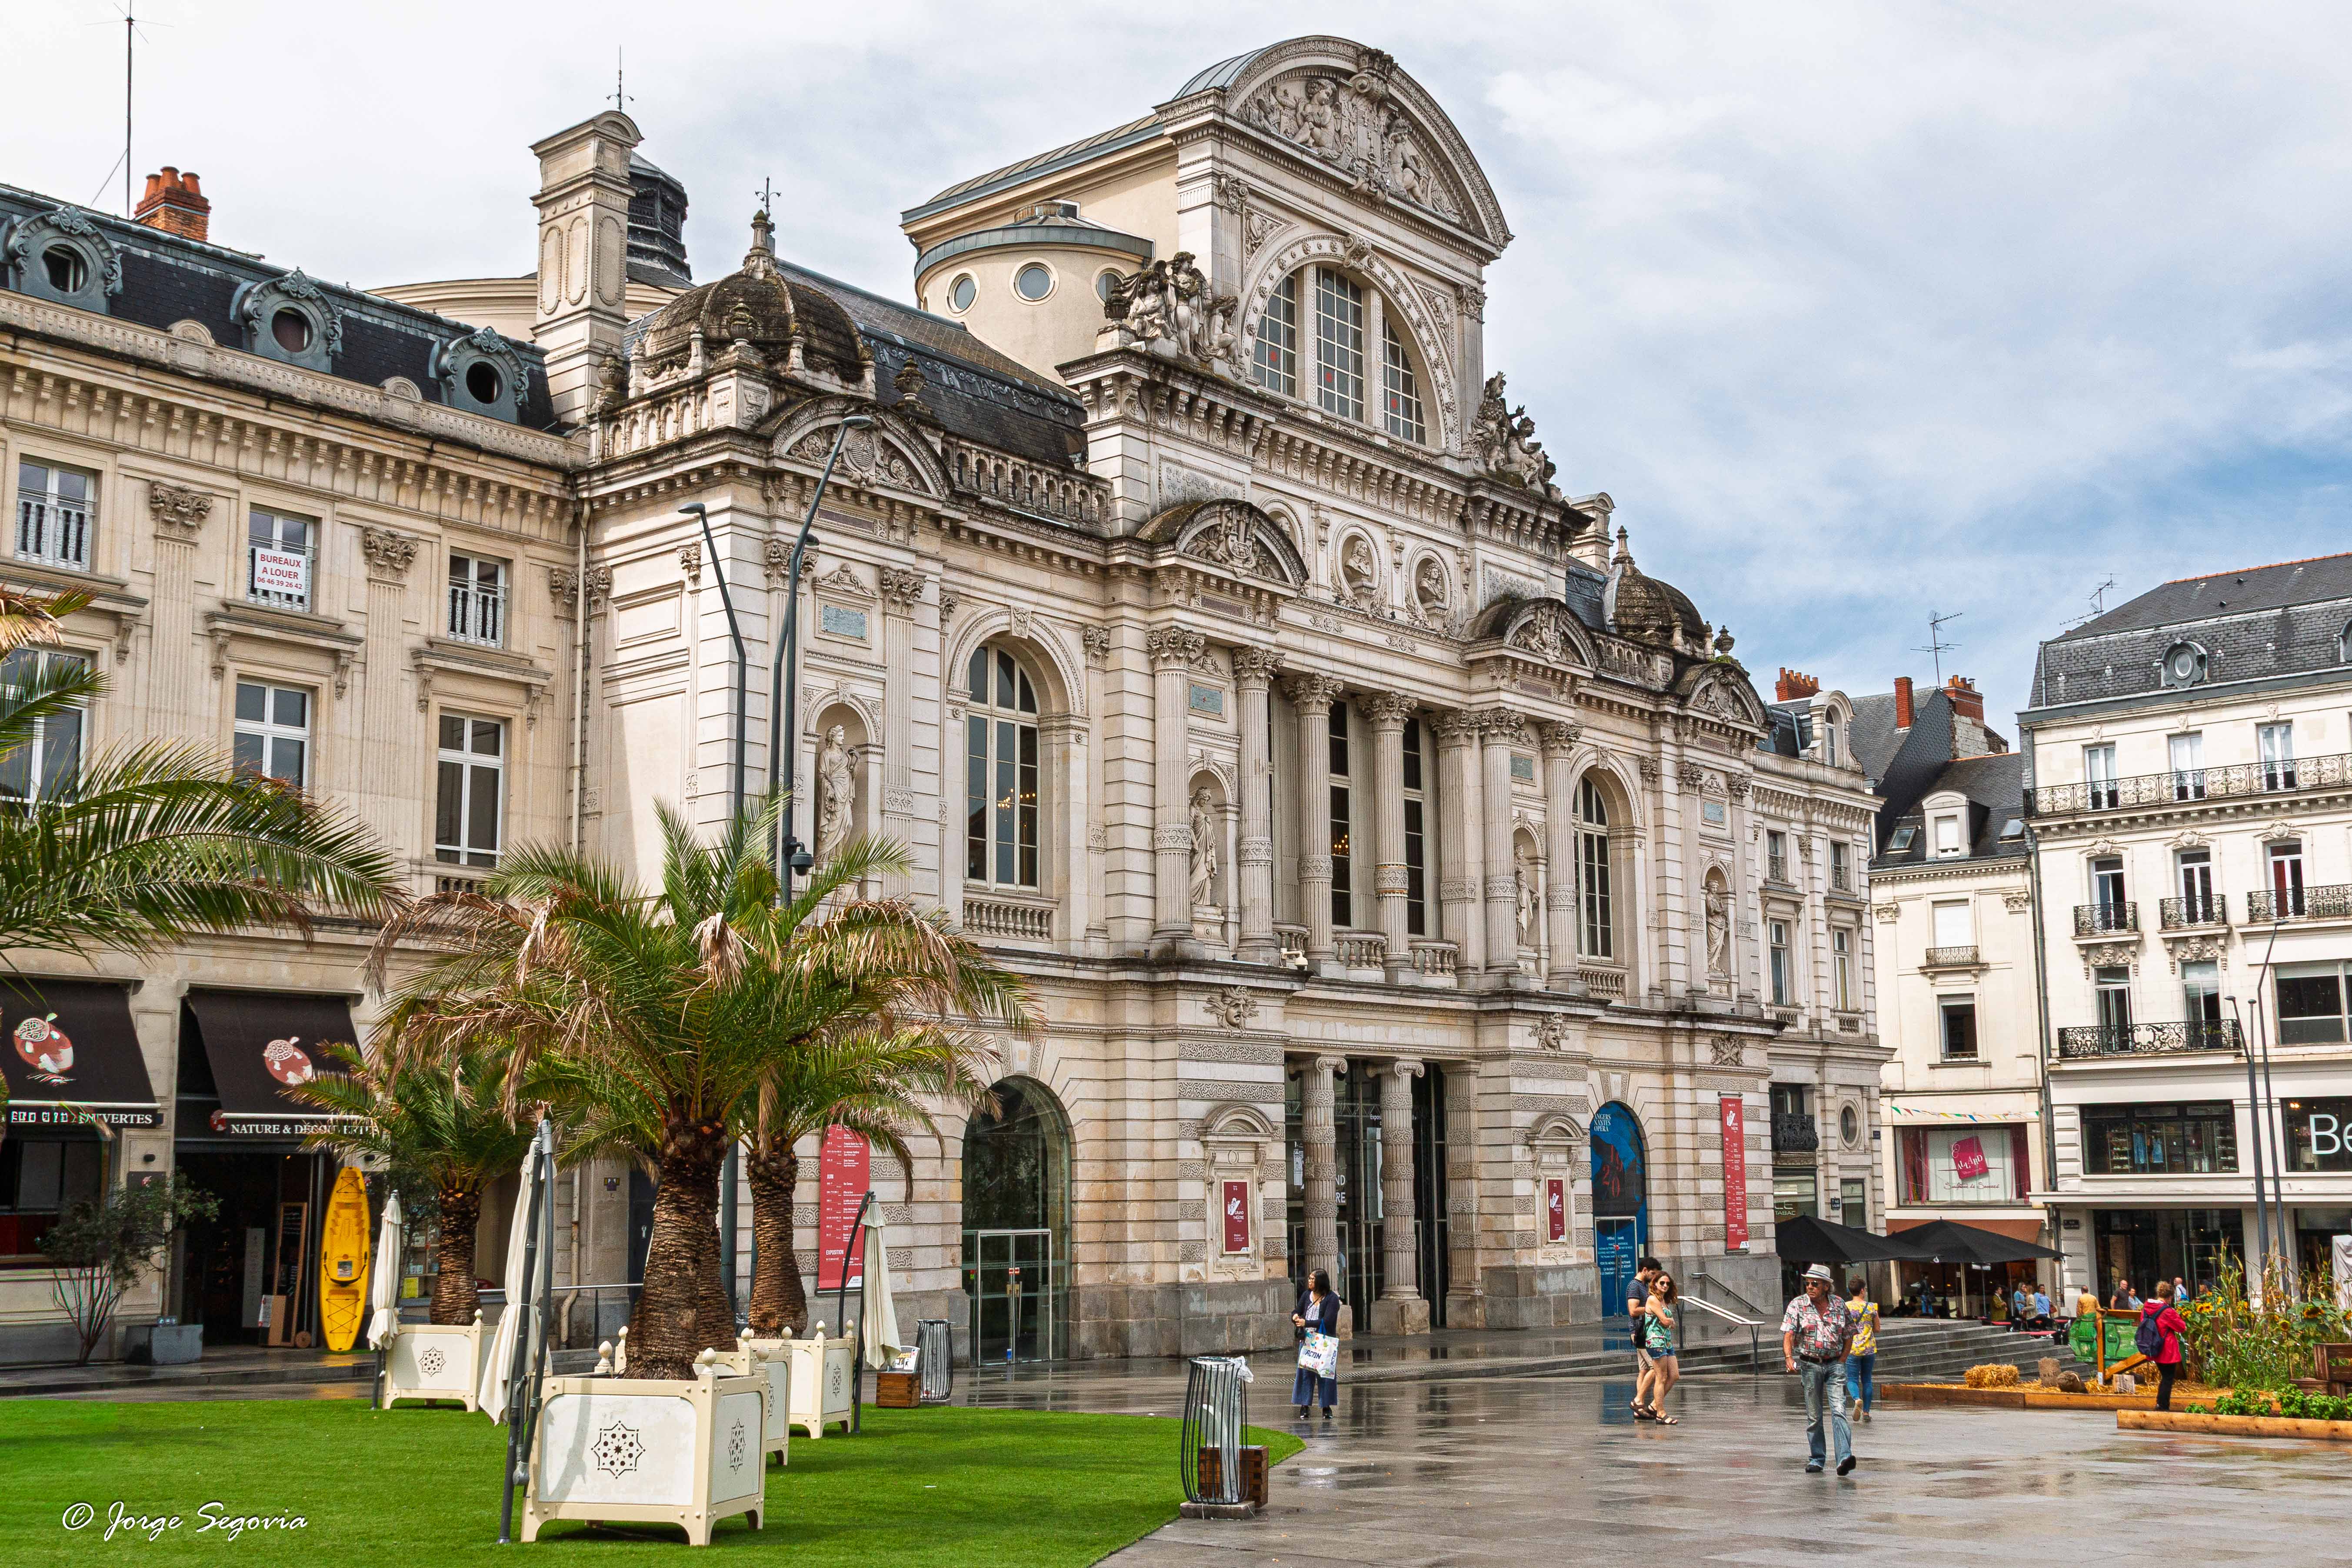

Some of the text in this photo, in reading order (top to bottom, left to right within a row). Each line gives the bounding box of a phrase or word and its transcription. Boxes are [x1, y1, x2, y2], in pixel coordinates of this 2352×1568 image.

[260, 554, 301, 568] BUREAUX
[270, 568, 298, 579] LOUER
[231, 1124, 280, 1134] NATURE
[283, 1125, 291, 1134] &
[1957, 1155, 1983, 1170] ALLARD
